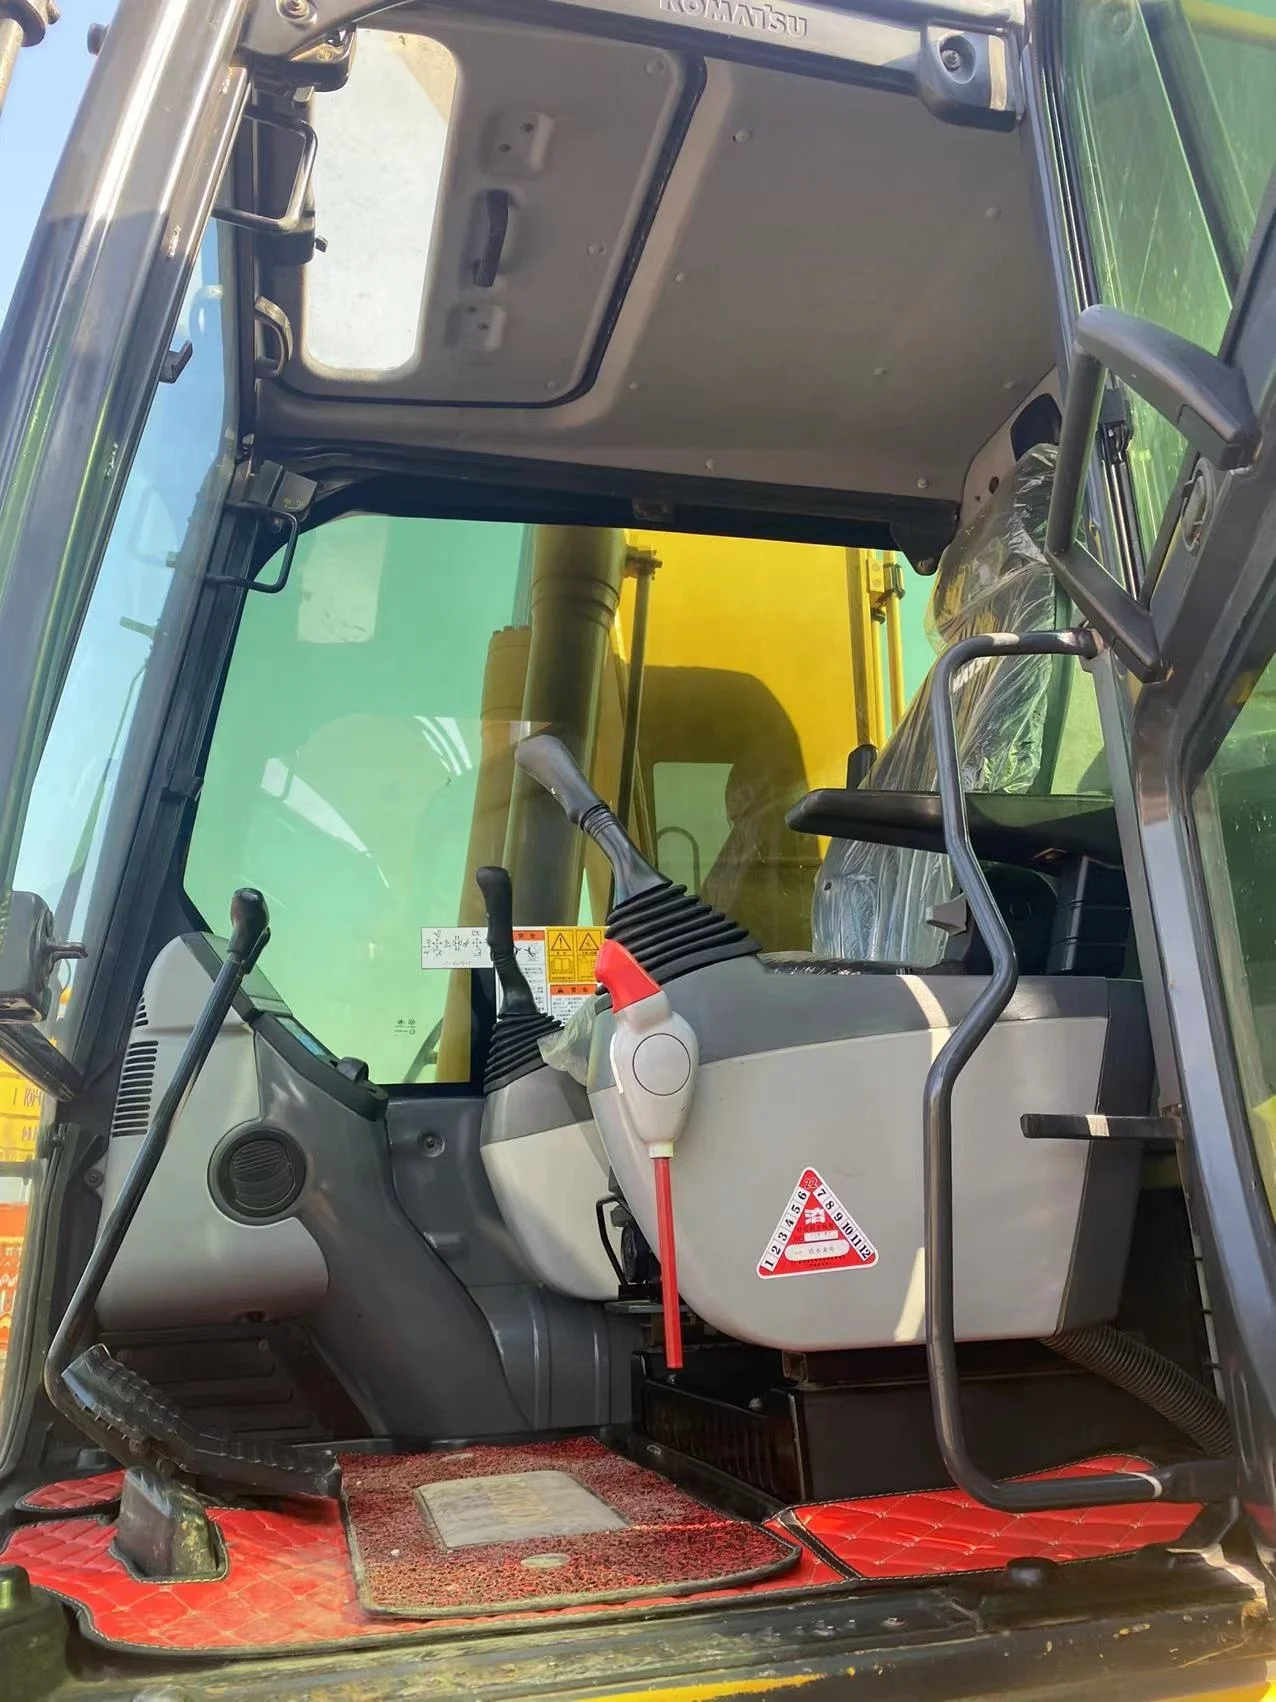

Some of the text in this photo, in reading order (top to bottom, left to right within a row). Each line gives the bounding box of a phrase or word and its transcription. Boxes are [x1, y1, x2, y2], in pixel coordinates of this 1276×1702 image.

[765, 1191, 807, 1268] 1 2 3 4 5 6
[817, 1188, 871, 1259] 7 8 9 10 11 12
